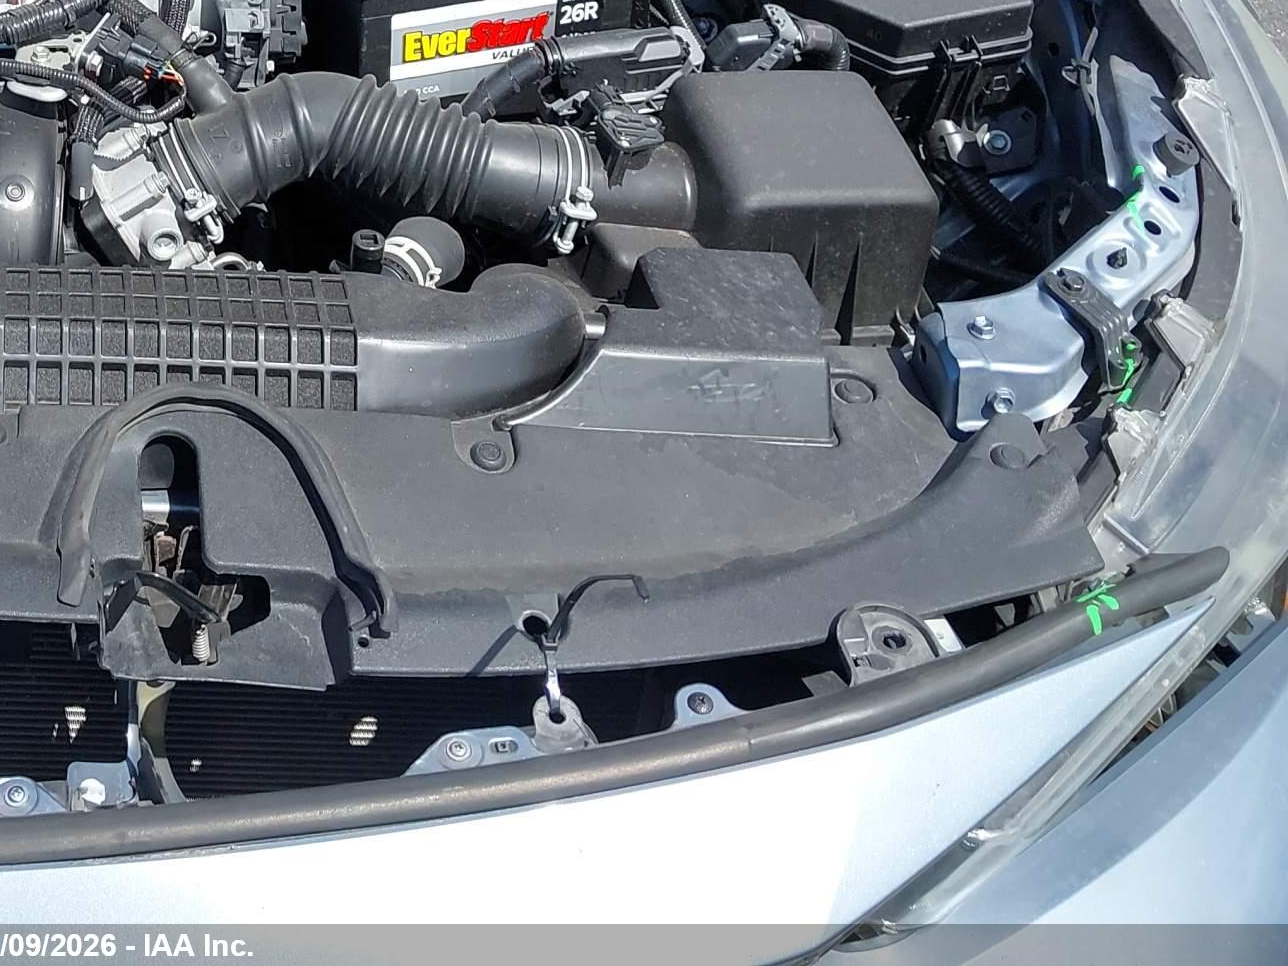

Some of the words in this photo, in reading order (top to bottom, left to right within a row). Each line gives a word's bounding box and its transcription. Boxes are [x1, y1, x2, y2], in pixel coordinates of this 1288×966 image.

[559, 1, 599, 25] 26R
[403, 12, 550, 63] EverStart
[422, 85, 440, 94] CCA
